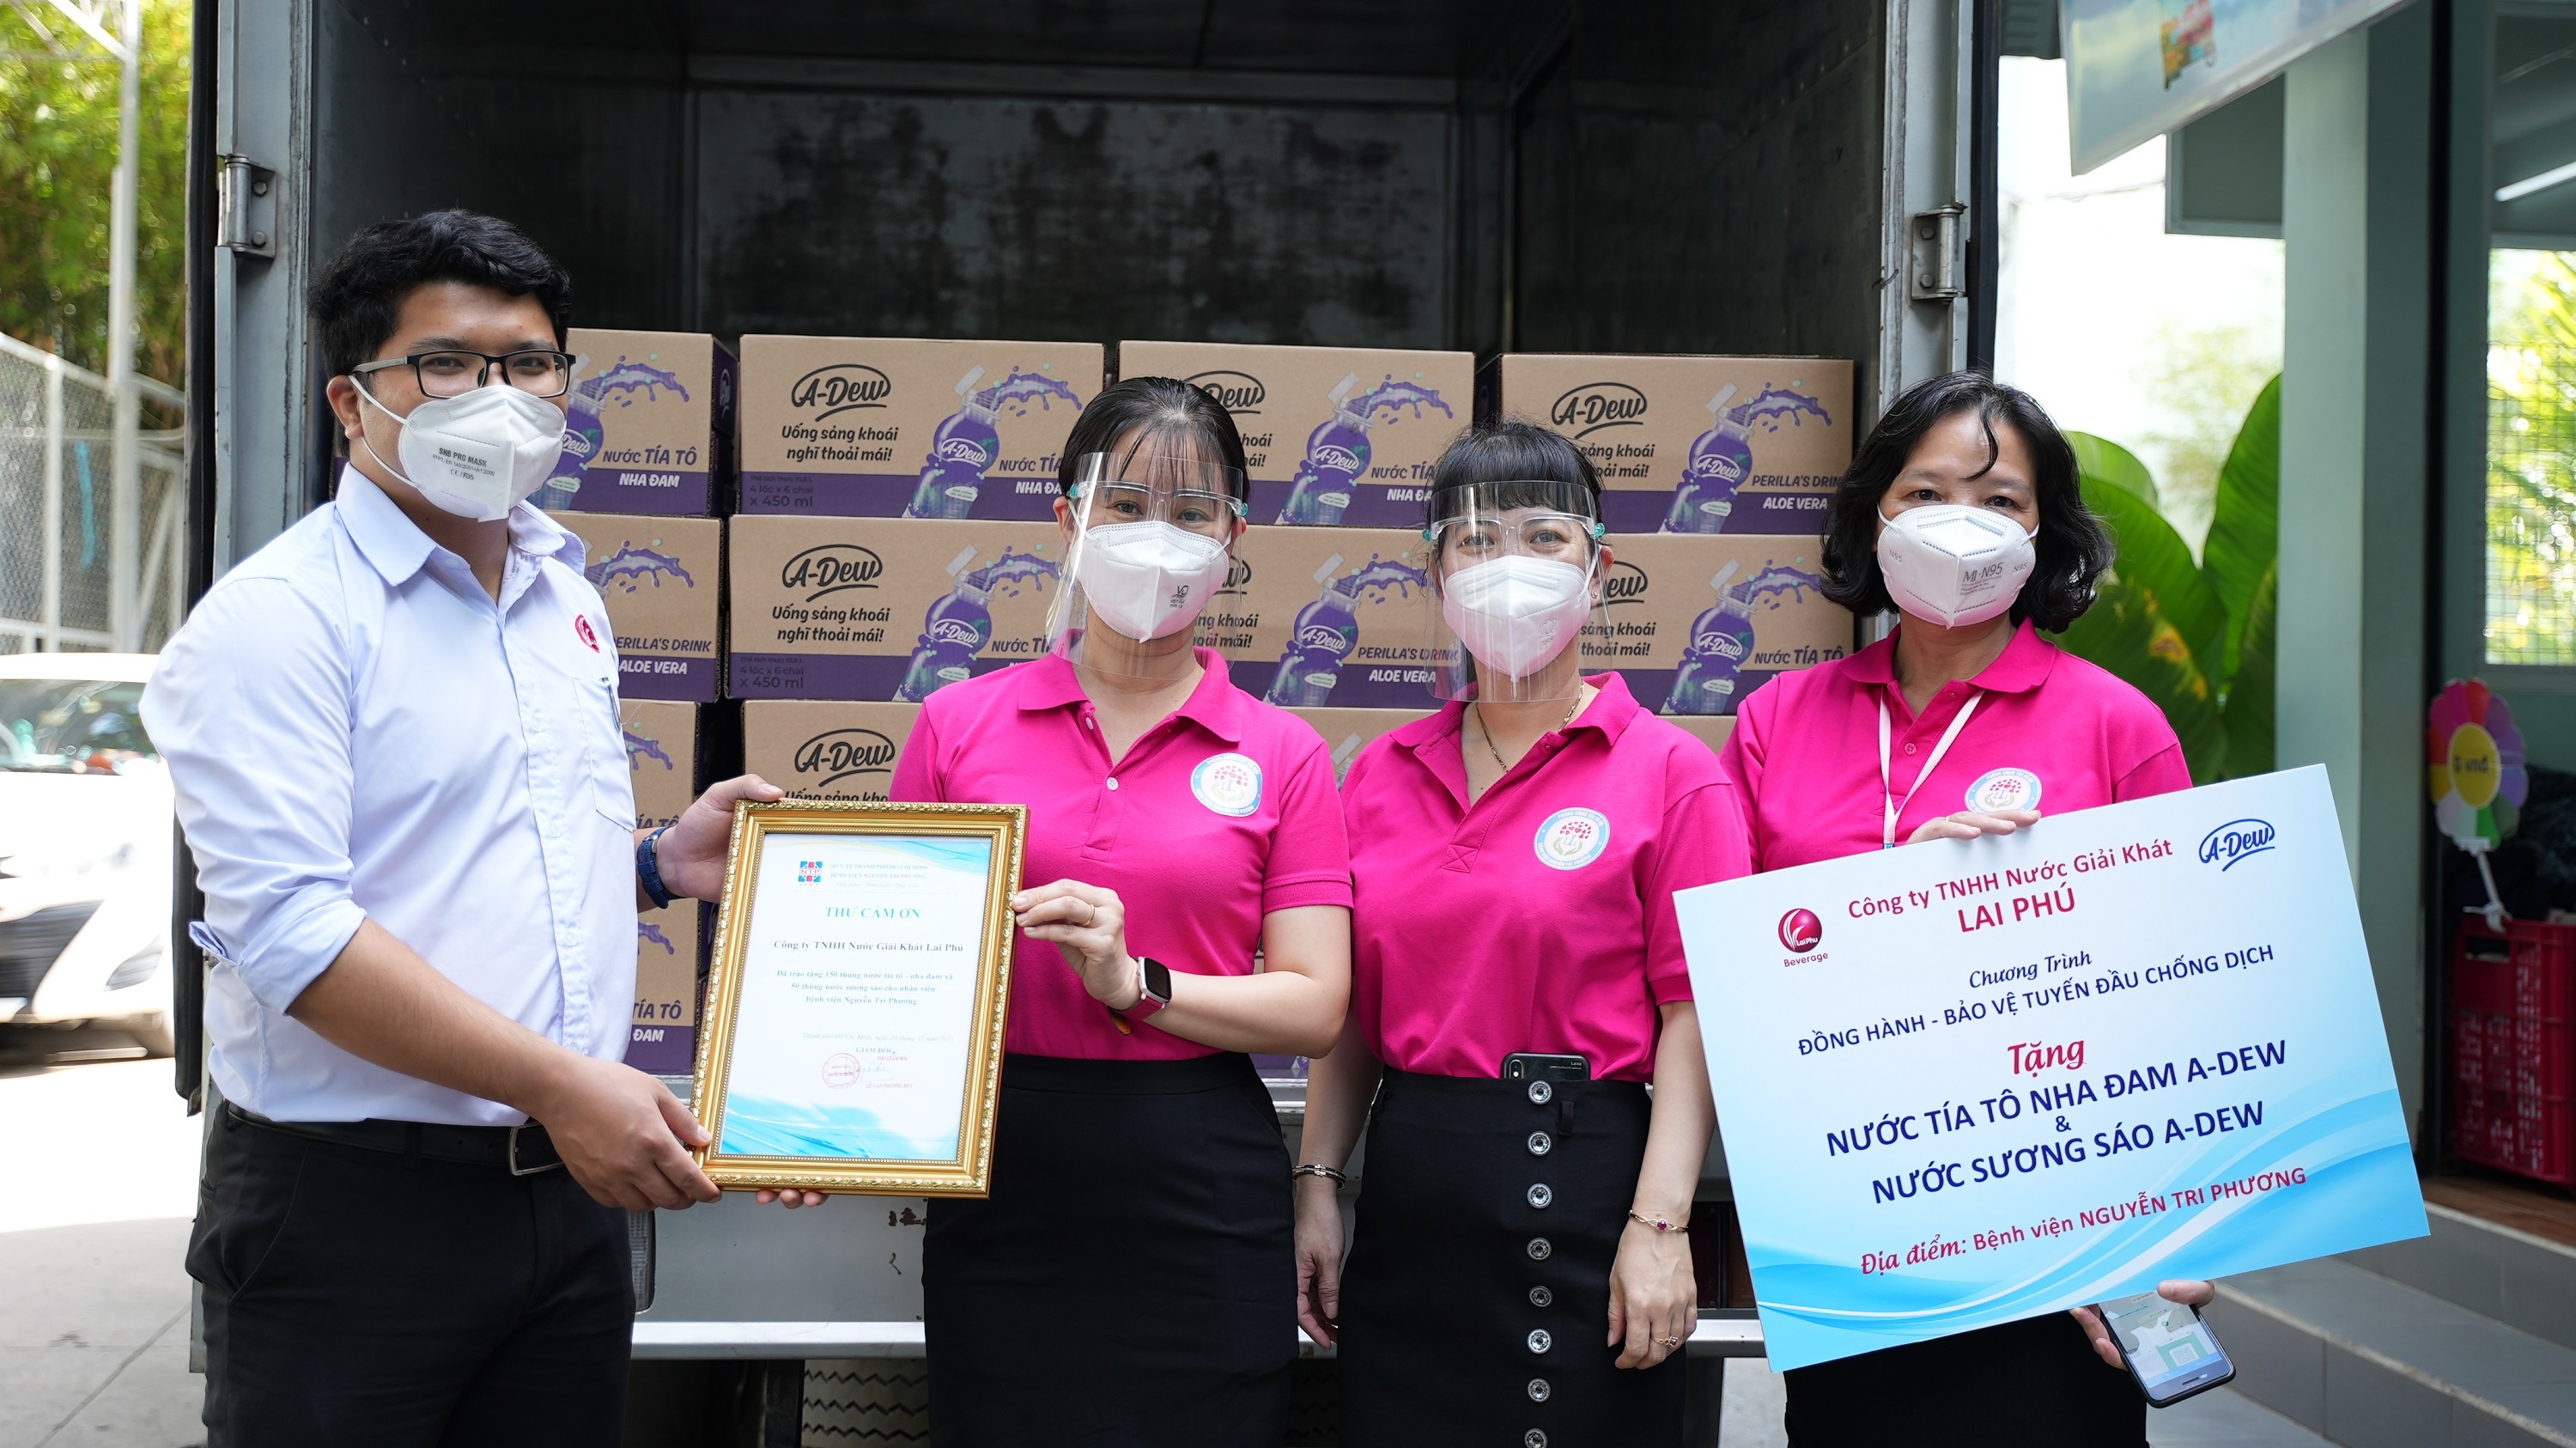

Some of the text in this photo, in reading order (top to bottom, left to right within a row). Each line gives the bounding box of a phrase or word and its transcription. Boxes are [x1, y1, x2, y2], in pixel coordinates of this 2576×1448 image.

[792, 373, 891, 409] A-Dew
[1552, 392, 1647, 426] A-Dew
[781, 423, 899, 442] Uống sảng khoái
[603, 444, 697, 465] NƯỚC TÍA TÔ
[787, 446, 892, 462] nghĩ thoải mái!
[941, 440, 987, 465] A-Dew
[1616, 443, 1655, 458] khoái
[453, 452, 466, 462] PRO
[468, 456, 487, 468] MASK
[999, 457, 1036, 472] NƯỚC
[1315, 447, 1359, 472] A-Dew
[1371, 465, 1407, 479] NƯỚC
[1619, 464, 1649, 478] mái!
[1697, 455, 1741, 482] A-Dew
[619, 472, 680, 488] NHA ĐAM
[1015, 481, 1063, 495] NHA ĐA
[1752, 475, 1811, 488] PERILLA'S
[762, 495, 790, 507] 450
[795, 496, 813, 507] ml
[1387, 488, 1413, 502] NHA
[1763, 496, 1829, 510] ALOE VERA
[782, 555, 883, 589] A-Dew
[772, 603, 890, 623] Uống sảng khoái
[777, 626, 884, 643] nghĩ thoải mái!
[933, 621, 980, 647] A-Dew
[1617, 622, 1656, 636] khoái
[615, 636, 670, 651] ERILLA'S
[671, 639, 712, 652] DRINK
[991, 637, 1029, 653] NƯỚC
[1301, 628, 1346, 652] A-Dew
[1697, 634, 1742, 659] A-Dew
[1358, 647, 1417, 660] PERILLA'S
[1620, 642, 1650, 656] mái!
[1754, 650, 1790, 664] NƯỚC
[1794, 645, 1819, 664] TÍA
[619, 659, 688, 674] ALOE VERA
[752, 676, 781, 688] 450
[785, 677, 804, 689] ml
[1369, 669, 1437, 683] ALOE VERA
[795, 739, 896, 773] A-Dew
[2199, 822, 2275, 865] A-Dew
[1849, 838, 2173, 920] Công ty TNHH Nước Giải Khát
[1958, 881, 2076, 933] LAI PHÚ
[774, 940, 799, 951] Công
[801, 941, 811, 951] ty
[813, 940, 845, 950] TNHH
[848, 941, 874, 951] Nước
[899, 941, 924, 952] Khát
[927, 942, 943, 952] Lai
[945, 942, 963, 952] Phú
[1783, 952, 1829, 968] Beverage
[1969, 951, 2093, 989] Chương Trình
[1798, 1028, 1861, 1056] ĐỒNG
[1866, 1015, 1926, 1043] HÀNH
[1943, 999, 1987, 1026] BẢO
[1992, 991, 2019, 1017] VỆ
[2022, 976, 2091, 1010] TUYẾN
[2095, 967, 2140, 995] ĐẦU
[2145, 953, 2220, 986] CHỐNG
[2225, 944, 2275, 970] DỊCH
[660, 1000, 682, 1019] TÔ
[633, 1028, 665, 1042] ĐAM
[2007, 1039, 2087, 1078] Tặng
[1826, 1039, 2287, 1157] NƯỚC TÍA TÔ NHA ĐAM A-DEW
[2055, 1115, 2072, 1132] &
[1872, 1100, 2265, 1204] NƯỚC SƯƠNG SÁO A-DEW
[1861, 1166, 2308, 1276] Địa điểm: Bệnh viện NGUYỄN TRI PHƯƠNG
